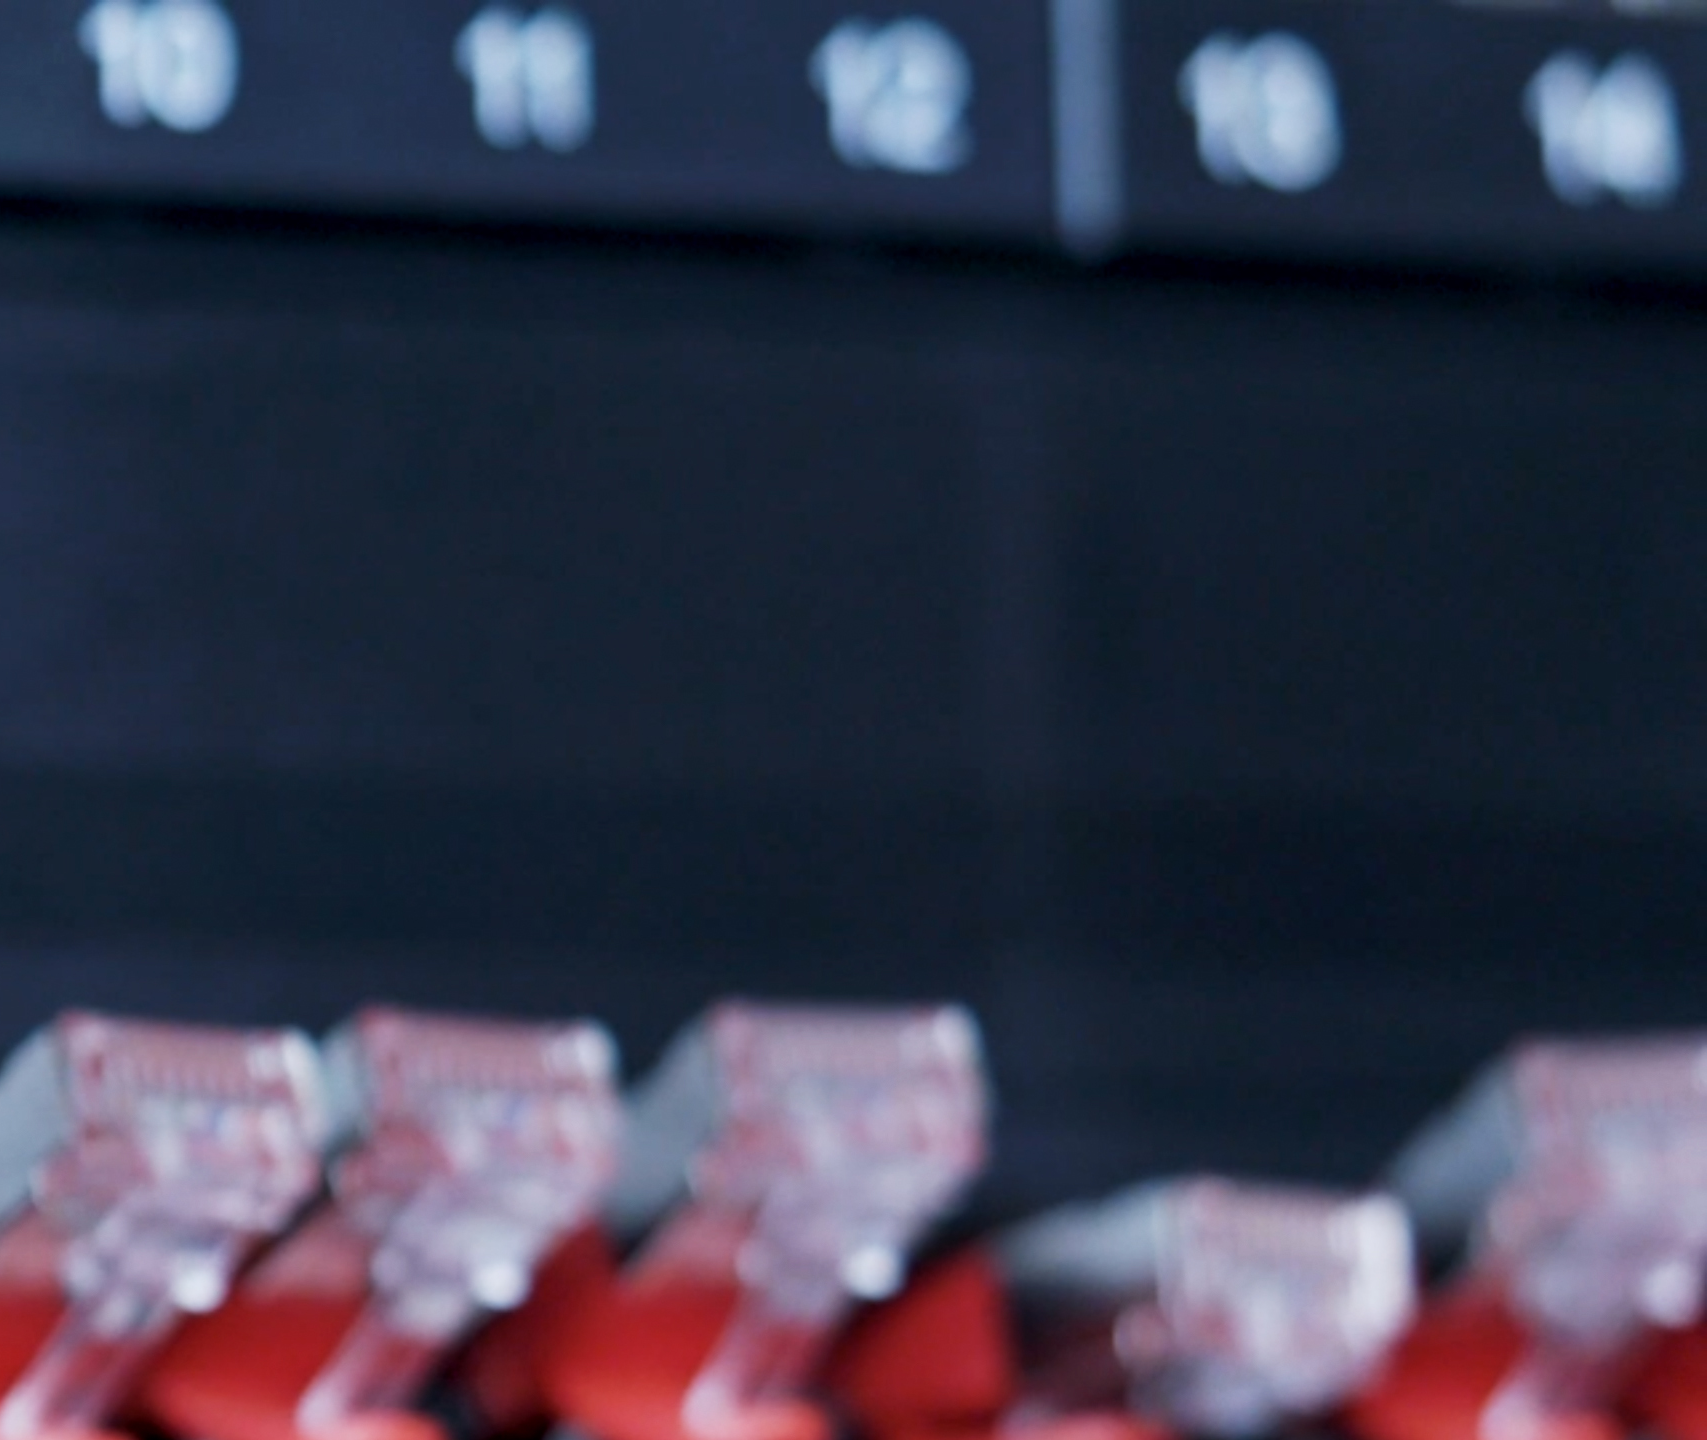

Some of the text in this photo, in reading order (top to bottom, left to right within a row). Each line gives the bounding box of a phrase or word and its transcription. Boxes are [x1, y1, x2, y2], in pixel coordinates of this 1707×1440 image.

[82, 0, 239, 132] 10
[455, 3, 595, 154] 11
[809, 18, 973, 174] 12
